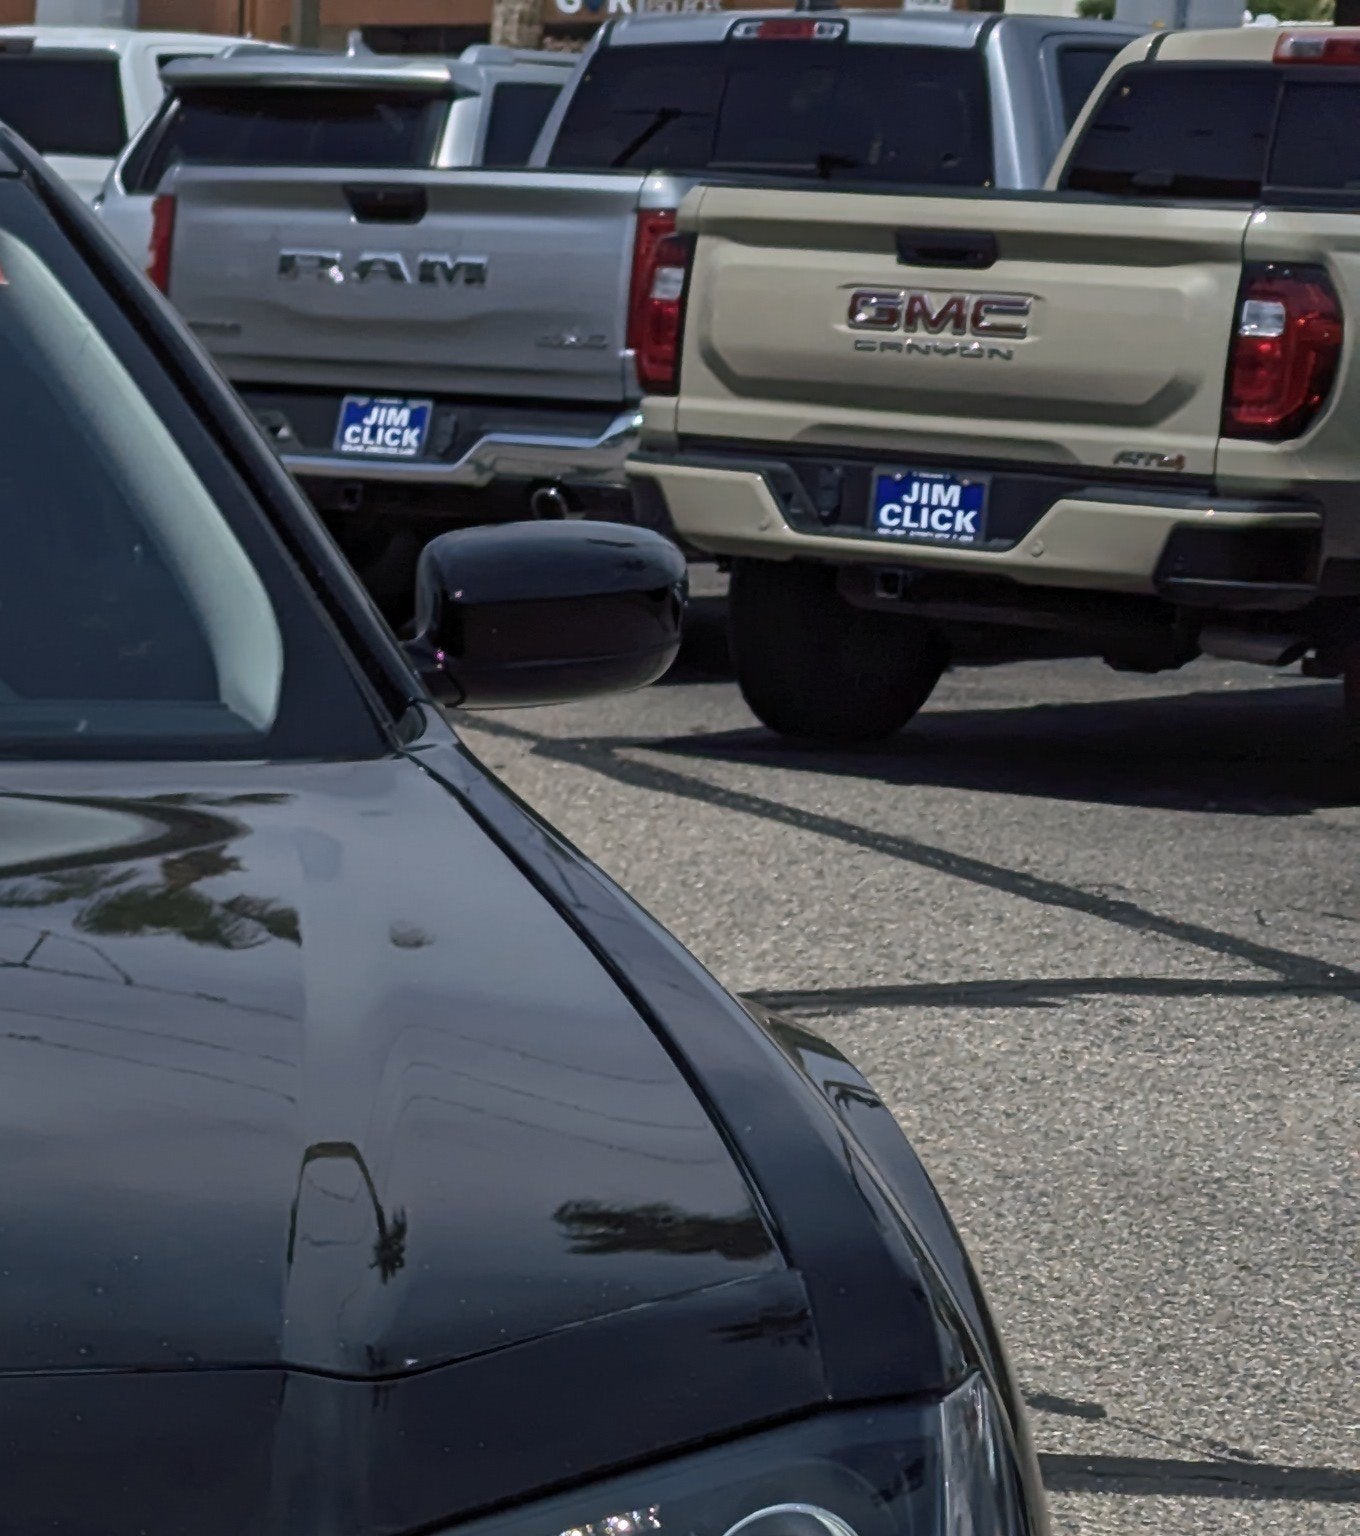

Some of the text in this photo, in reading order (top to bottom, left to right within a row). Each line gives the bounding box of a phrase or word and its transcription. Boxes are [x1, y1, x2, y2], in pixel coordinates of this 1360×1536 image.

[278, 248, 488, 284] RAM
[848, 288, 1032, 340] GMC
[854, 340, 1014, 361] CANYON
[362, 405, 411, 428] JIM
[344, 424, 420, 448] CLICK
[901, 481, 962, 508] JIM
[879, 503, 978, 534] CLICK
